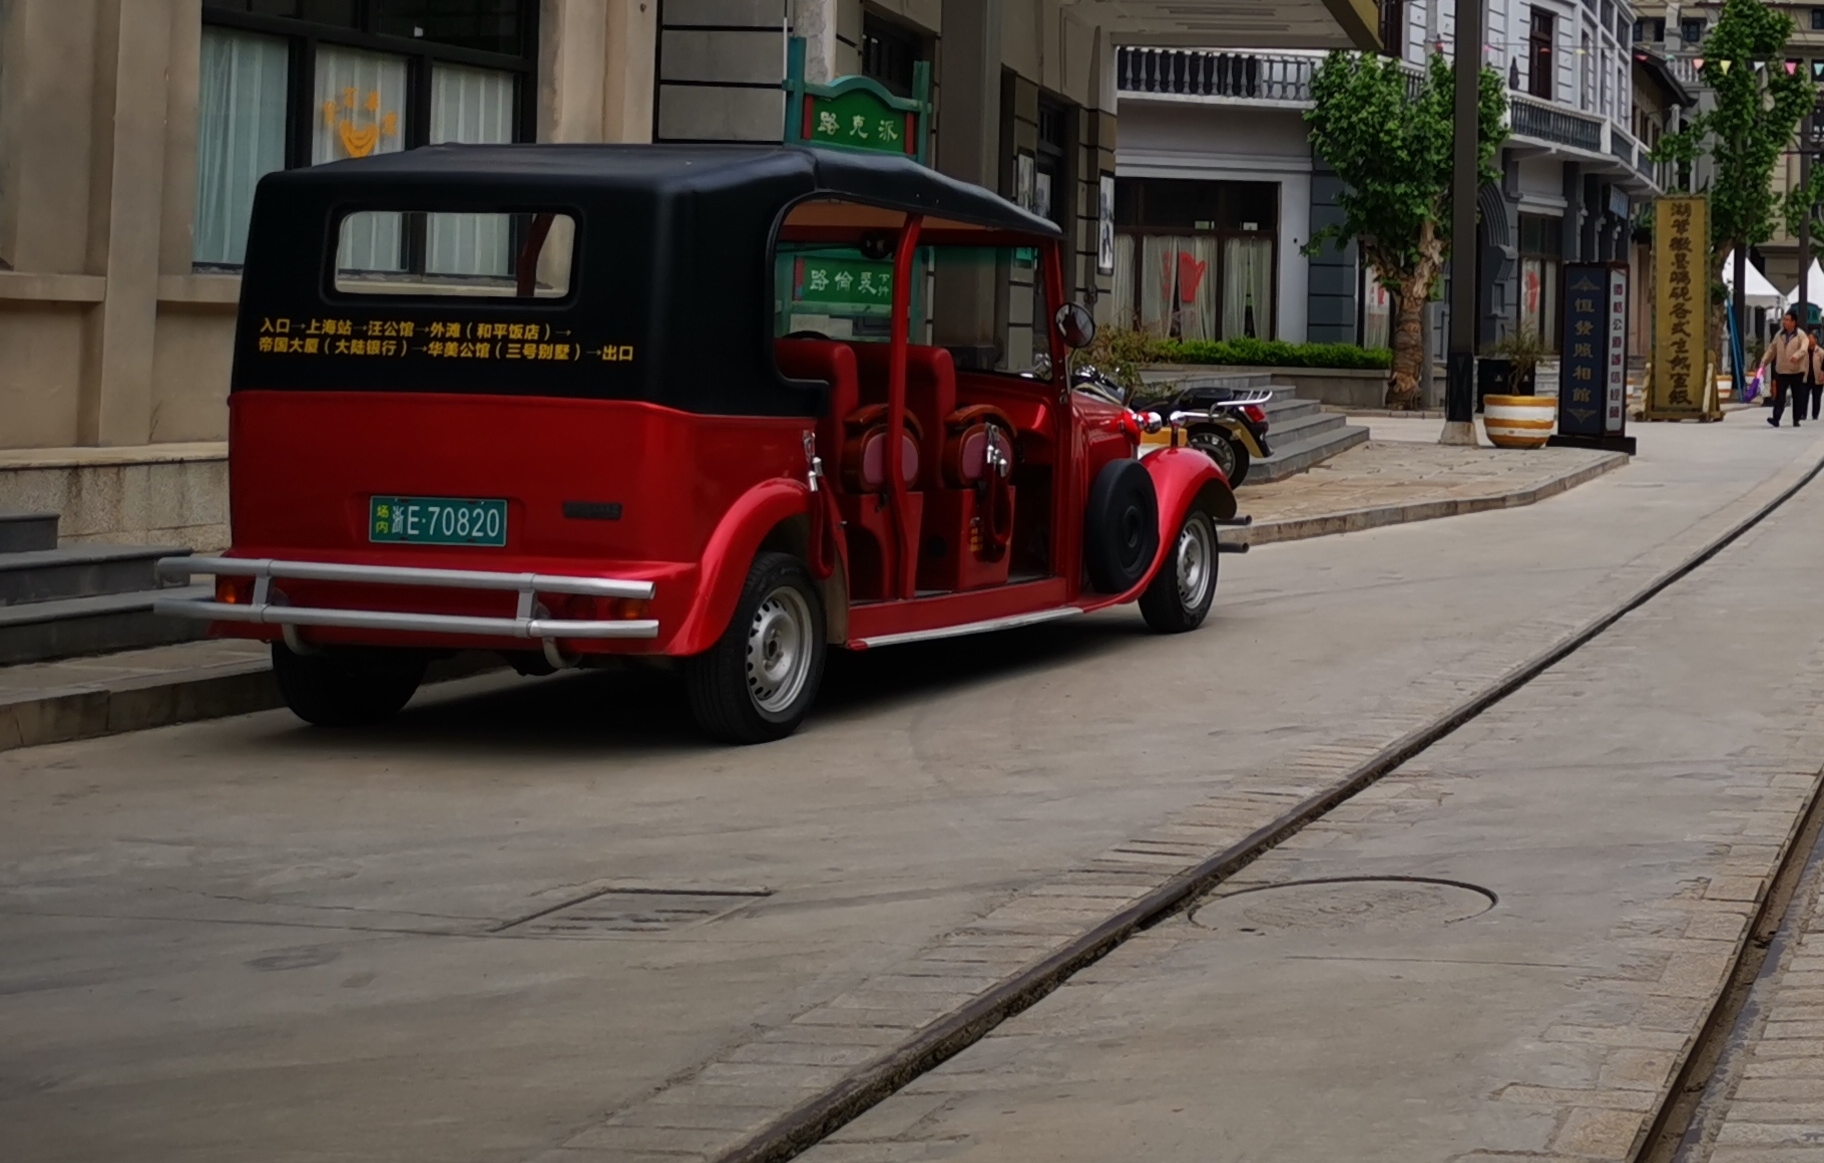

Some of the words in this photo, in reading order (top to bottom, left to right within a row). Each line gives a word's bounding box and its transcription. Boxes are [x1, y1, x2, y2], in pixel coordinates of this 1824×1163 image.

[260, 318, 290, 334] 入口
[305, 319, 353, 335] 上海站
[368, 321, 415, 337] 汪公馆
[602, 345, 634, 361] 出口
